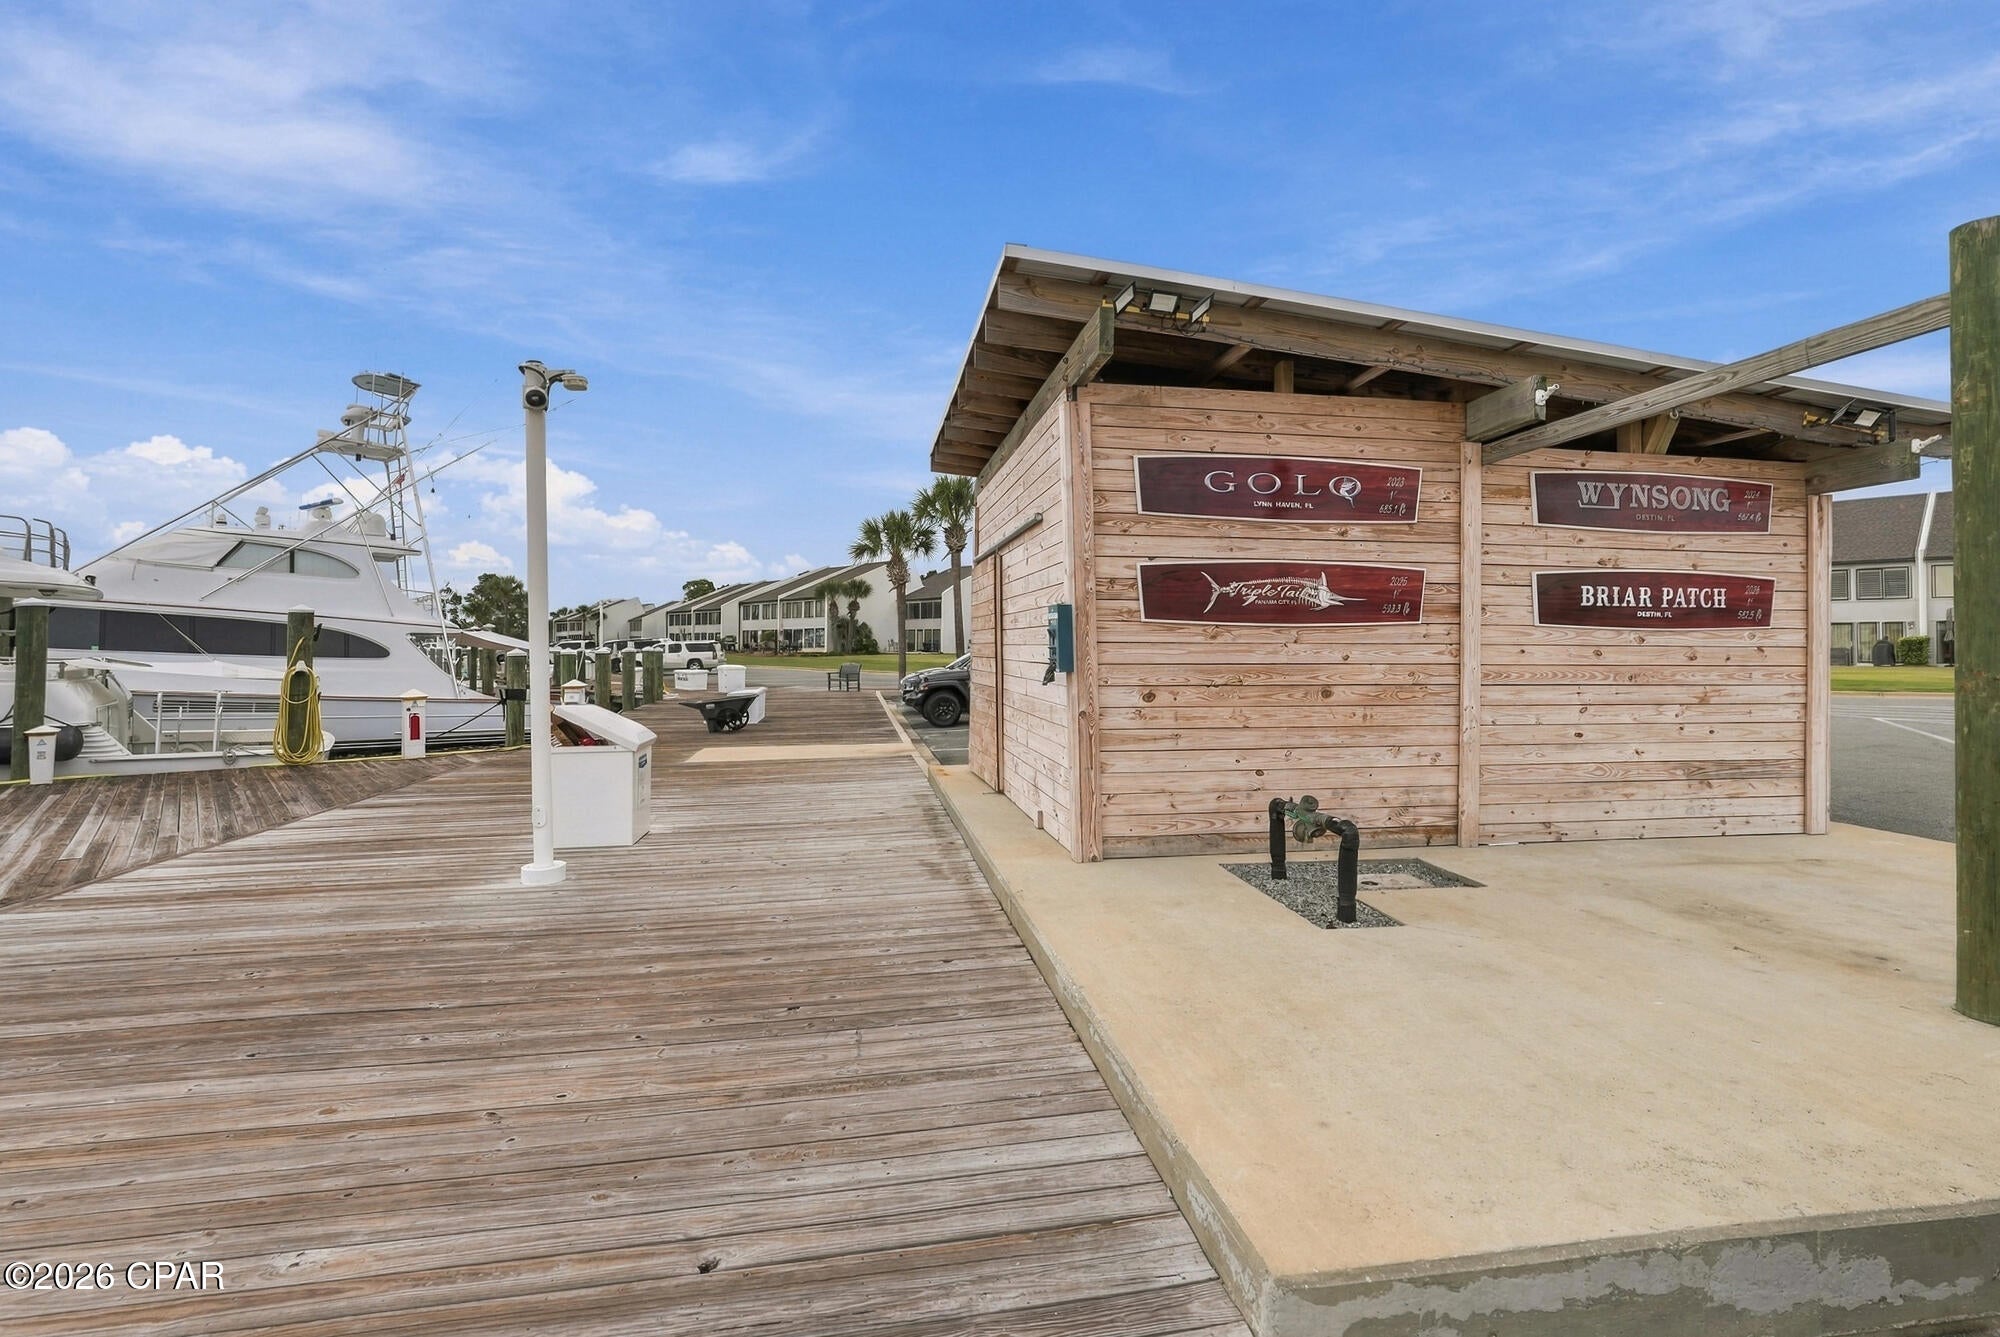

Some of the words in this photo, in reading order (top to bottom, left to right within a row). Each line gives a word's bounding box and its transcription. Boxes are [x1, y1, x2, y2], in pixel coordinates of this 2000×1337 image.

[1203, 470, 1362, 498] GOLO
[1253, 500, 1273, 508] LYNN
[1577, 481, 1732, 512] WYNSONG
[1667, 514, 1676, 522] FL
[1229, 582, 1279, 606] Triple
[1580, 585, 1653, 607] BRIAR
[1660, 587, 1727, 608] PATCH
